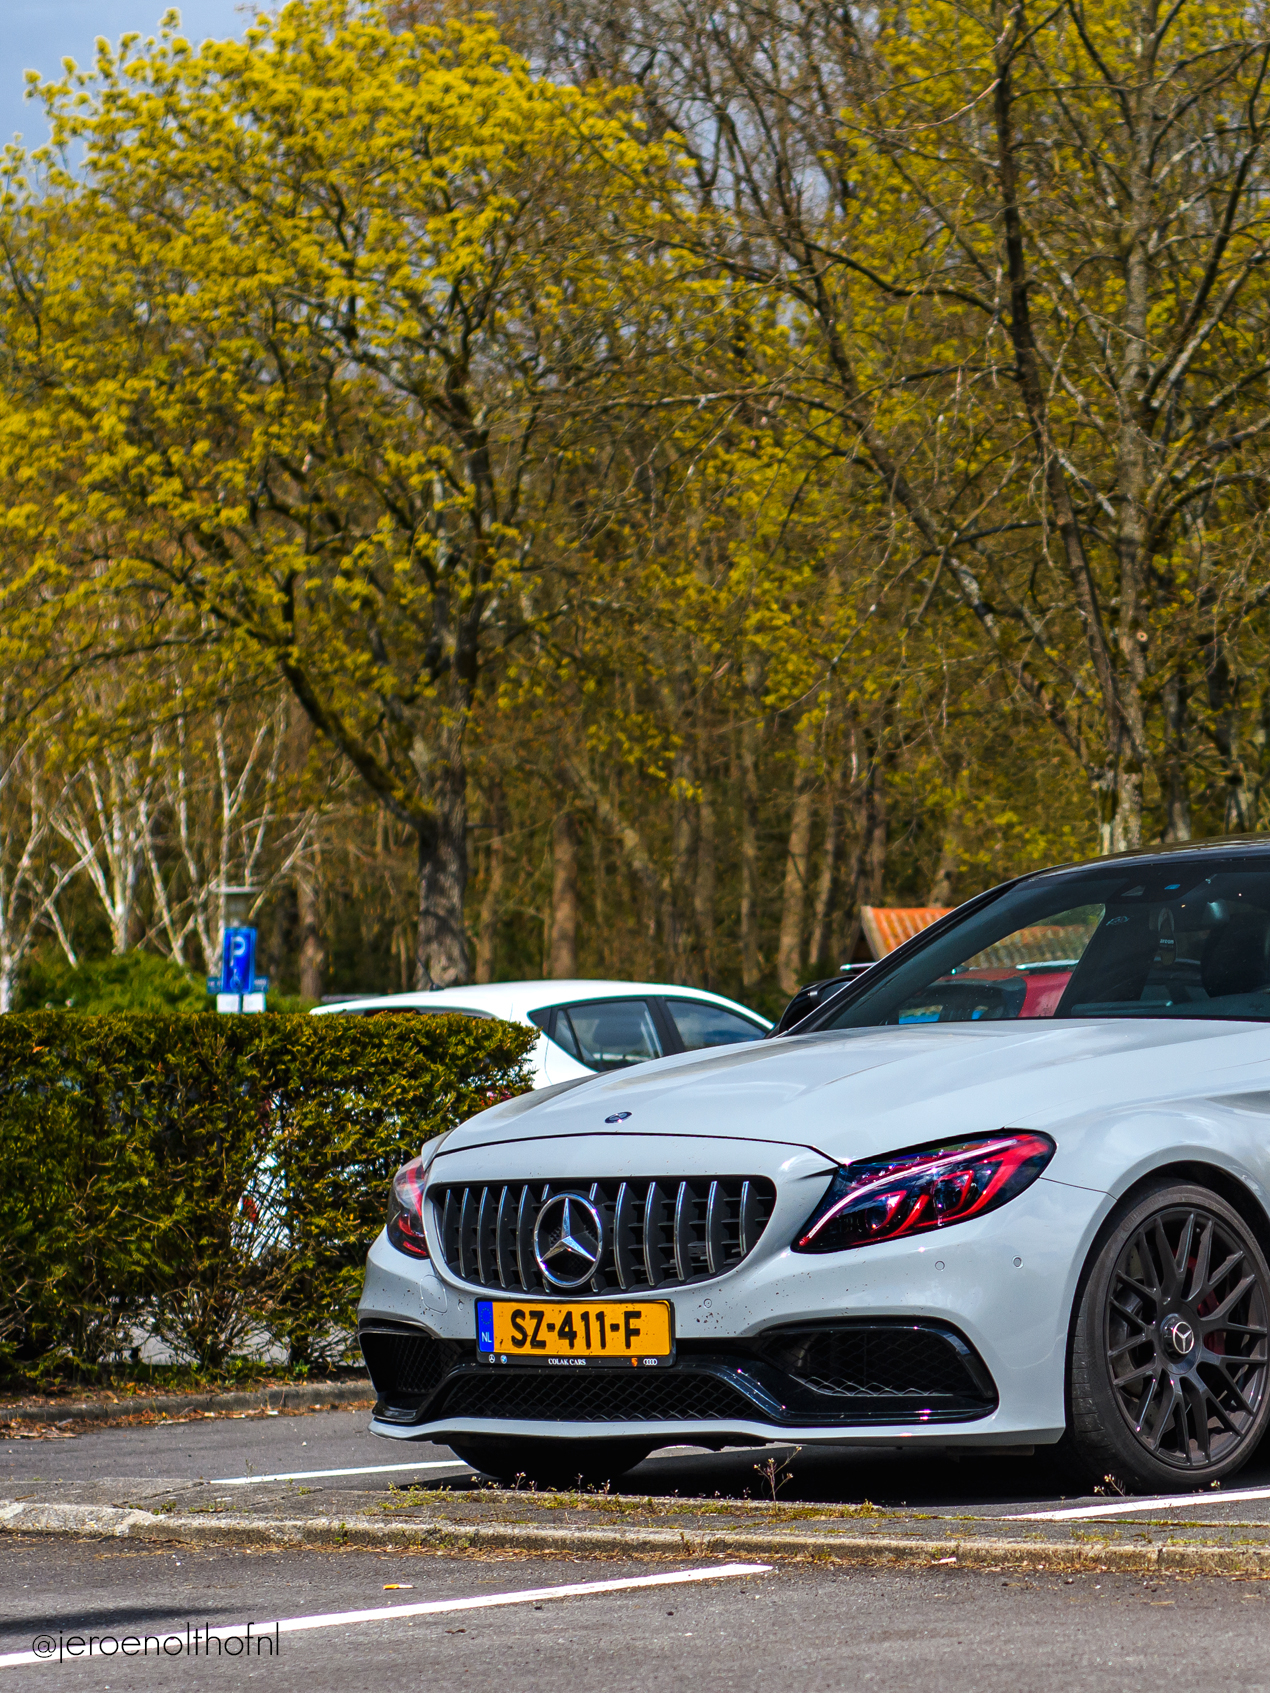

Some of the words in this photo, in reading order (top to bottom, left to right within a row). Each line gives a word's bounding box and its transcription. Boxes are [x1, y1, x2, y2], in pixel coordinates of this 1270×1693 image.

[230, 936, 246, 966] P
[481, 1331, 493, 1343] NL
[510, 1308, 642, 1350] SZ-411-F
[548, 1358, 569, 1366] COLAK
[569, 1358, 587, 1366] CARS
